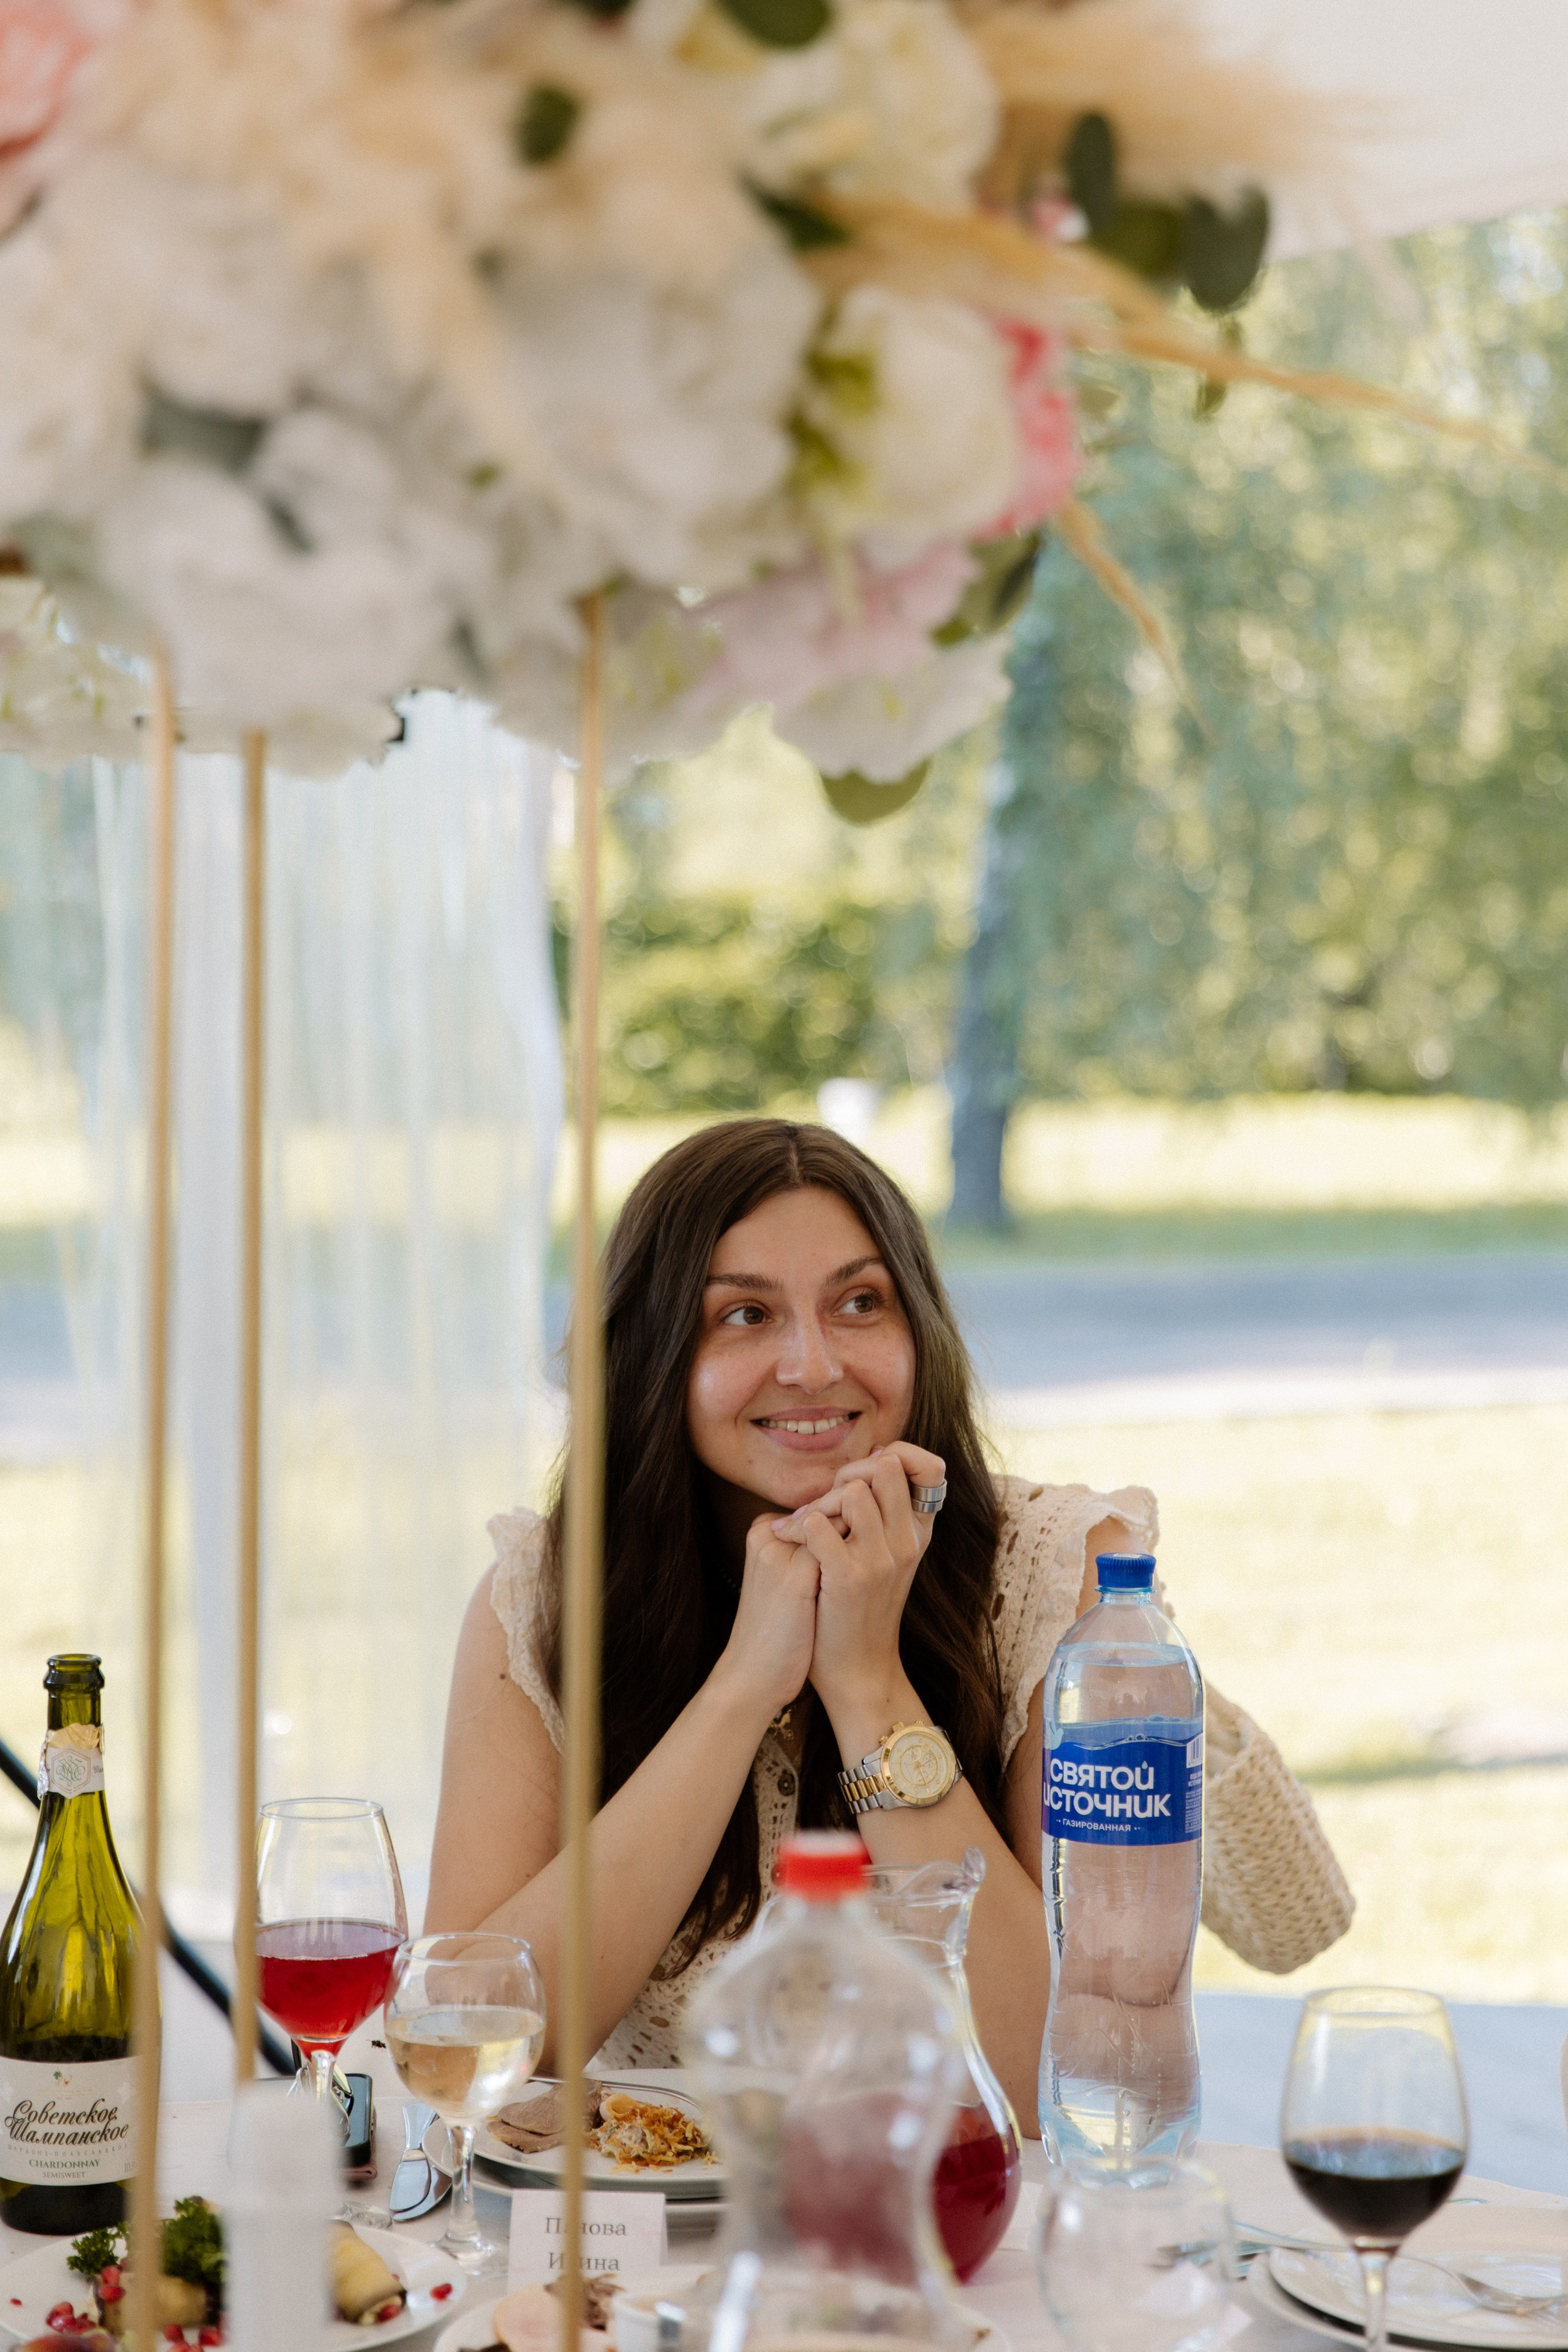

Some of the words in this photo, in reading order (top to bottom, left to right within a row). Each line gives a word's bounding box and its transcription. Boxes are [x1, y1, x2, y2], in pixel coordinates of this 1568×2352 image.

[1050, 1758, 1155, 1790] СВЯТОЙ
[1043, 1782, 1171, 1819] ИСТОЧНИК
[1062, 1818, 1131, 1832] ГАЗИРОВАННАЯ
[12, 2098, 118, 2125] Советское
[4, 2116, 129, 2146] Шампанское
[29, 2159, 101, 2169] CHARDONNAY
[548, 2252, 620, 2271] Иина
